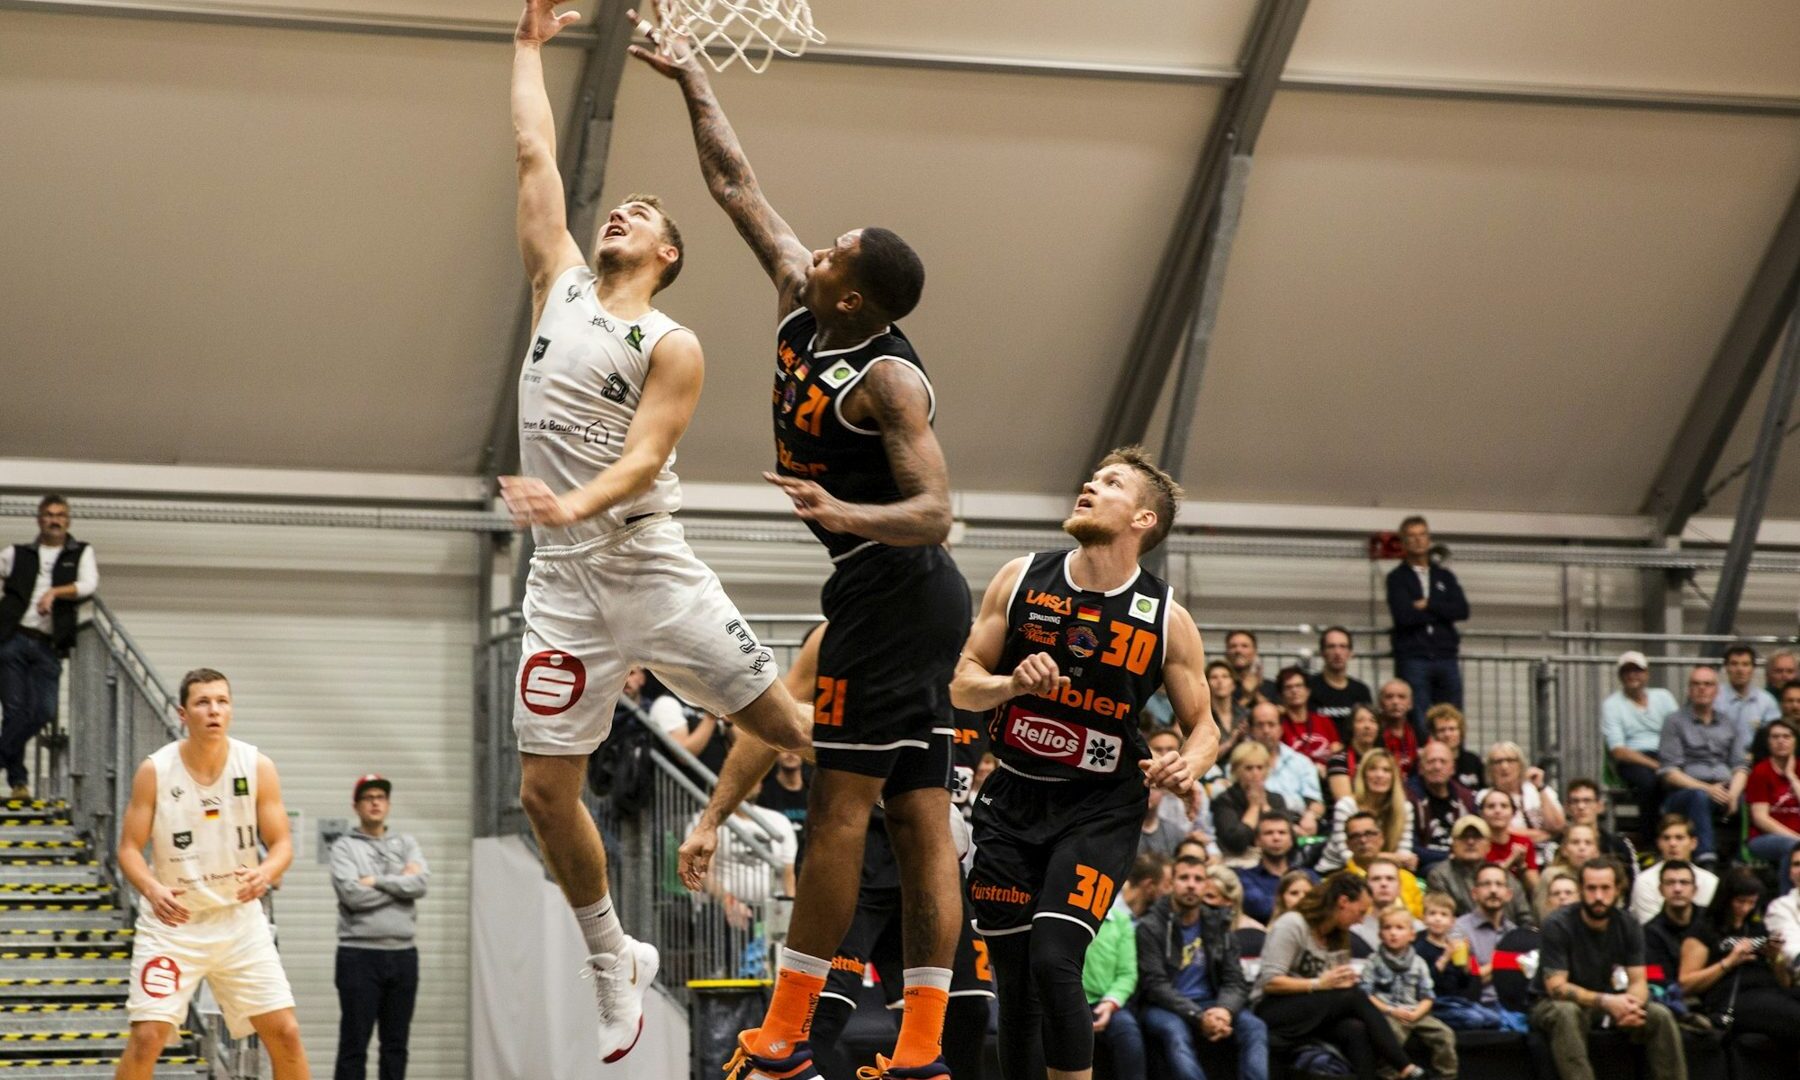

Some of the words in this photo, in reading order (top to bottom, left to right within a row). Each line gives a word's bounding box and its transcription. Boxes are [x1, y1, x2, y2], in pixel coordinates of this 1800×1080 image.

[794, 384, 830, 437] 21
[1029, 612, 1061, 625] SPALDING
[1100, 620, 1158, 676] 30
[814, 676, 847, 727] 21
[1011, 718, 1080, 753] Helios
[236, 824, 255, 850] 11
[971, 880, 1031, 905] fürstenber
[1067, 863, 1115, 921] 30
